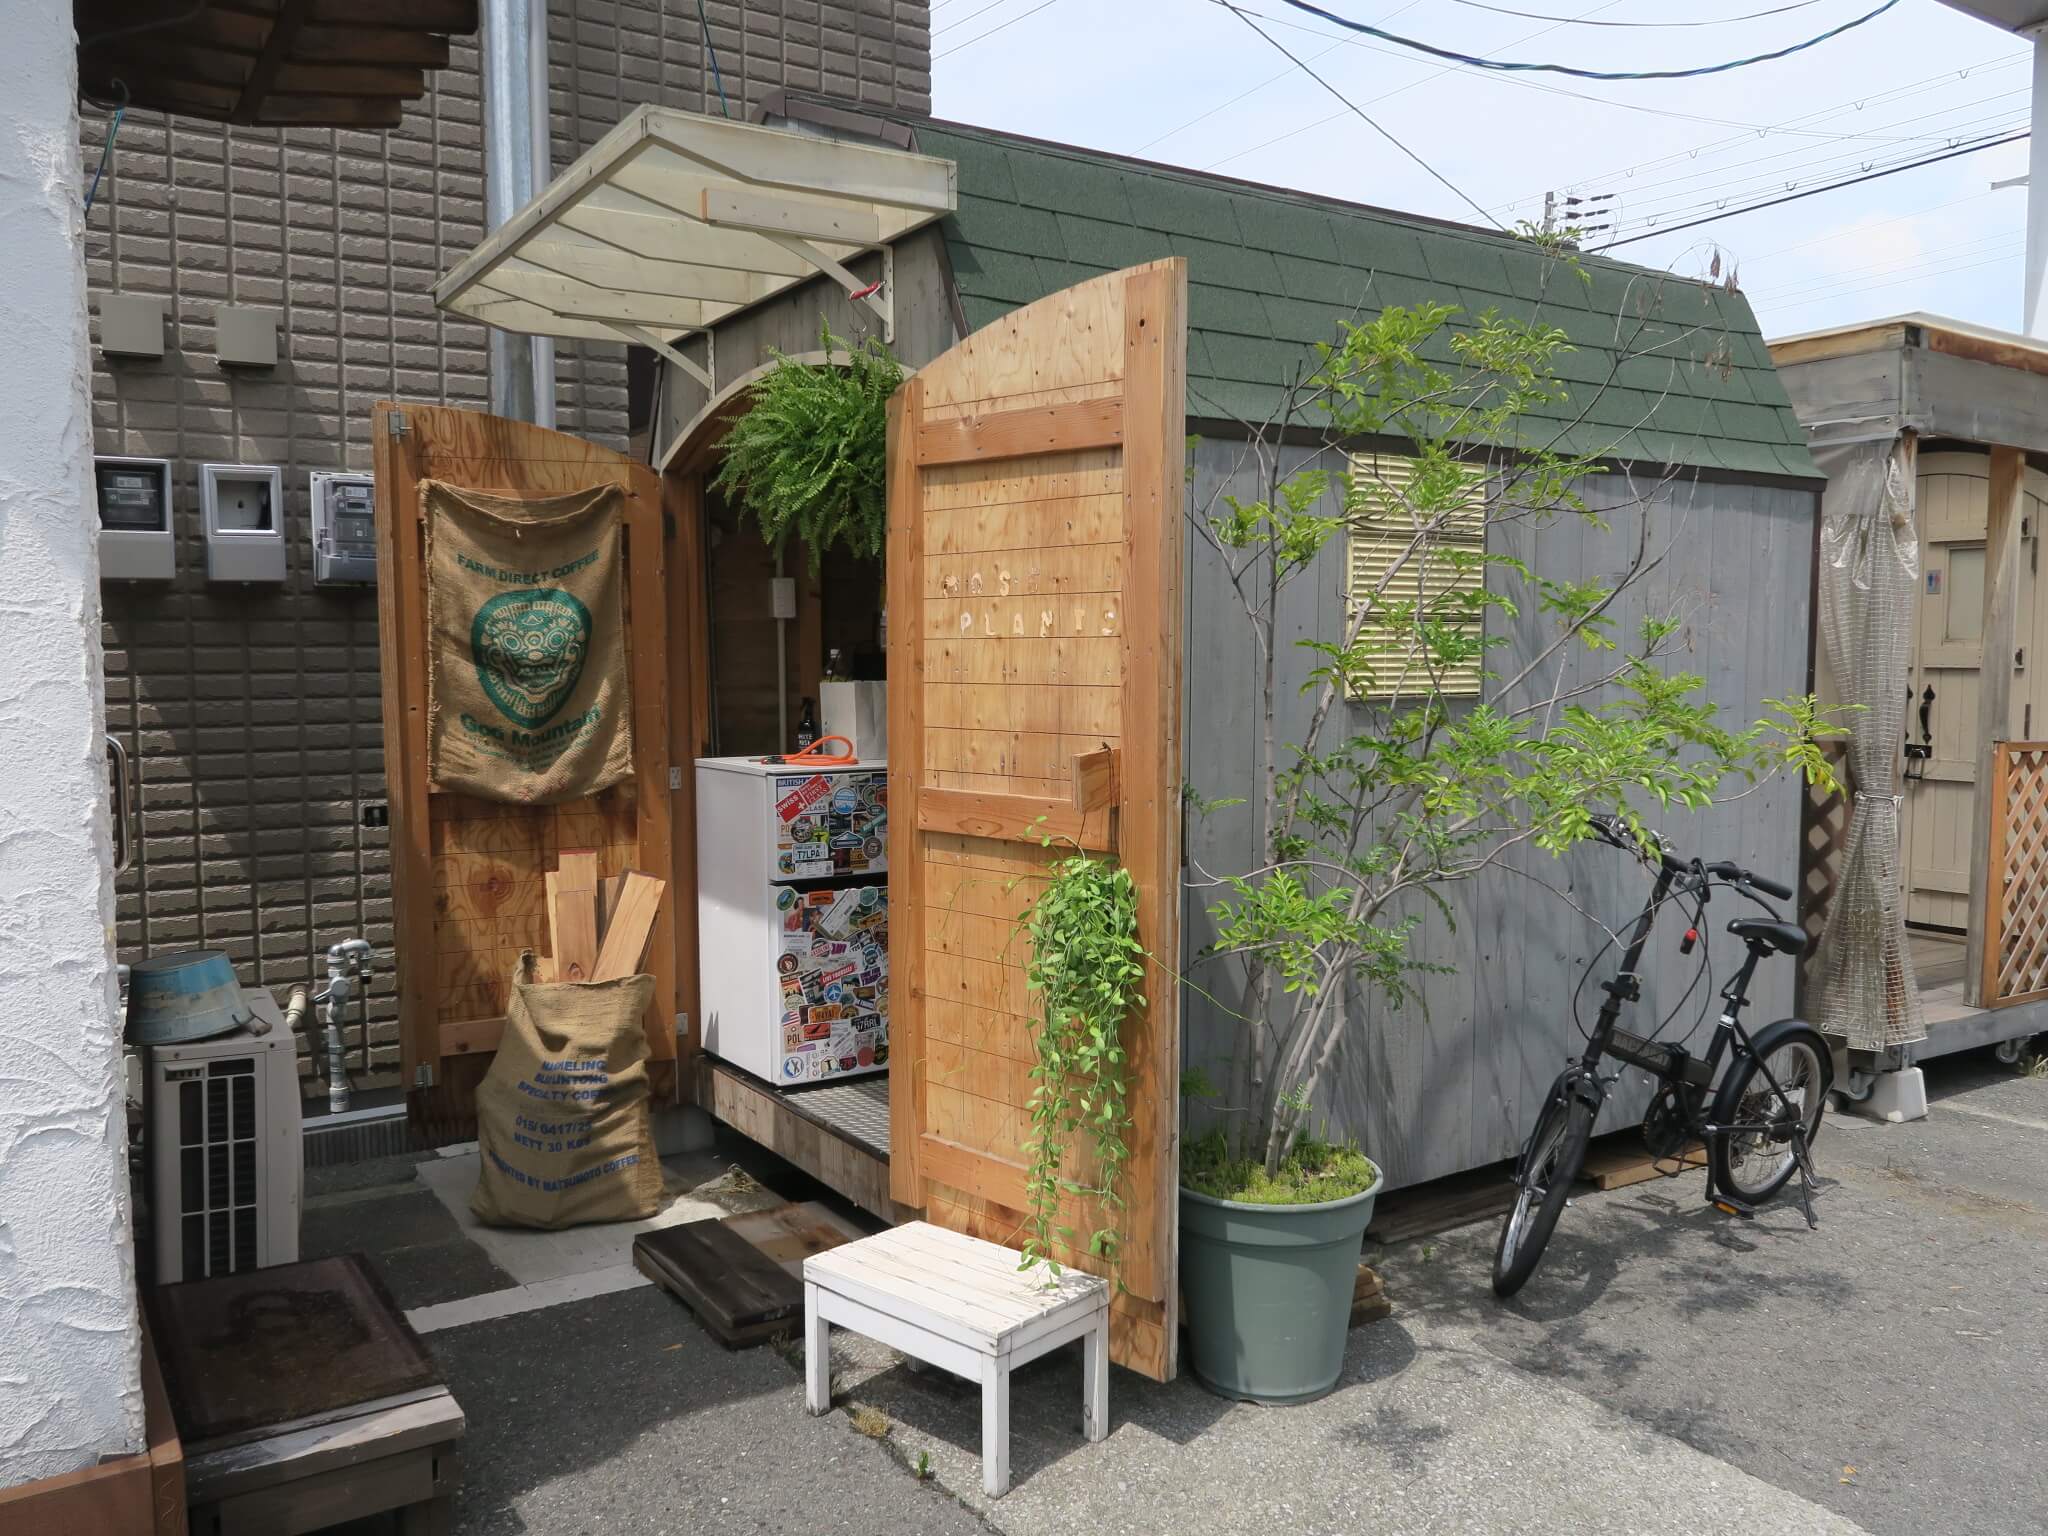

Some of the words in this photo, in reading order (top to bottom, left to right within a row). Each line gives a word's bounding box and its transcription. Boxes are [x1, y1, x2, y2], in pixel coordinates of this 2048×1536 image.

[457, 552, 496, 578] FARM
[499, 570, 549, 586] DIRECT
[551, 549, 600, 578] COFFEE
[777, 794, 798, 812] SWISS
[548, 1141, 563, 1153] 30
[543, 1168, 601, 1192] MATSUMOTO
